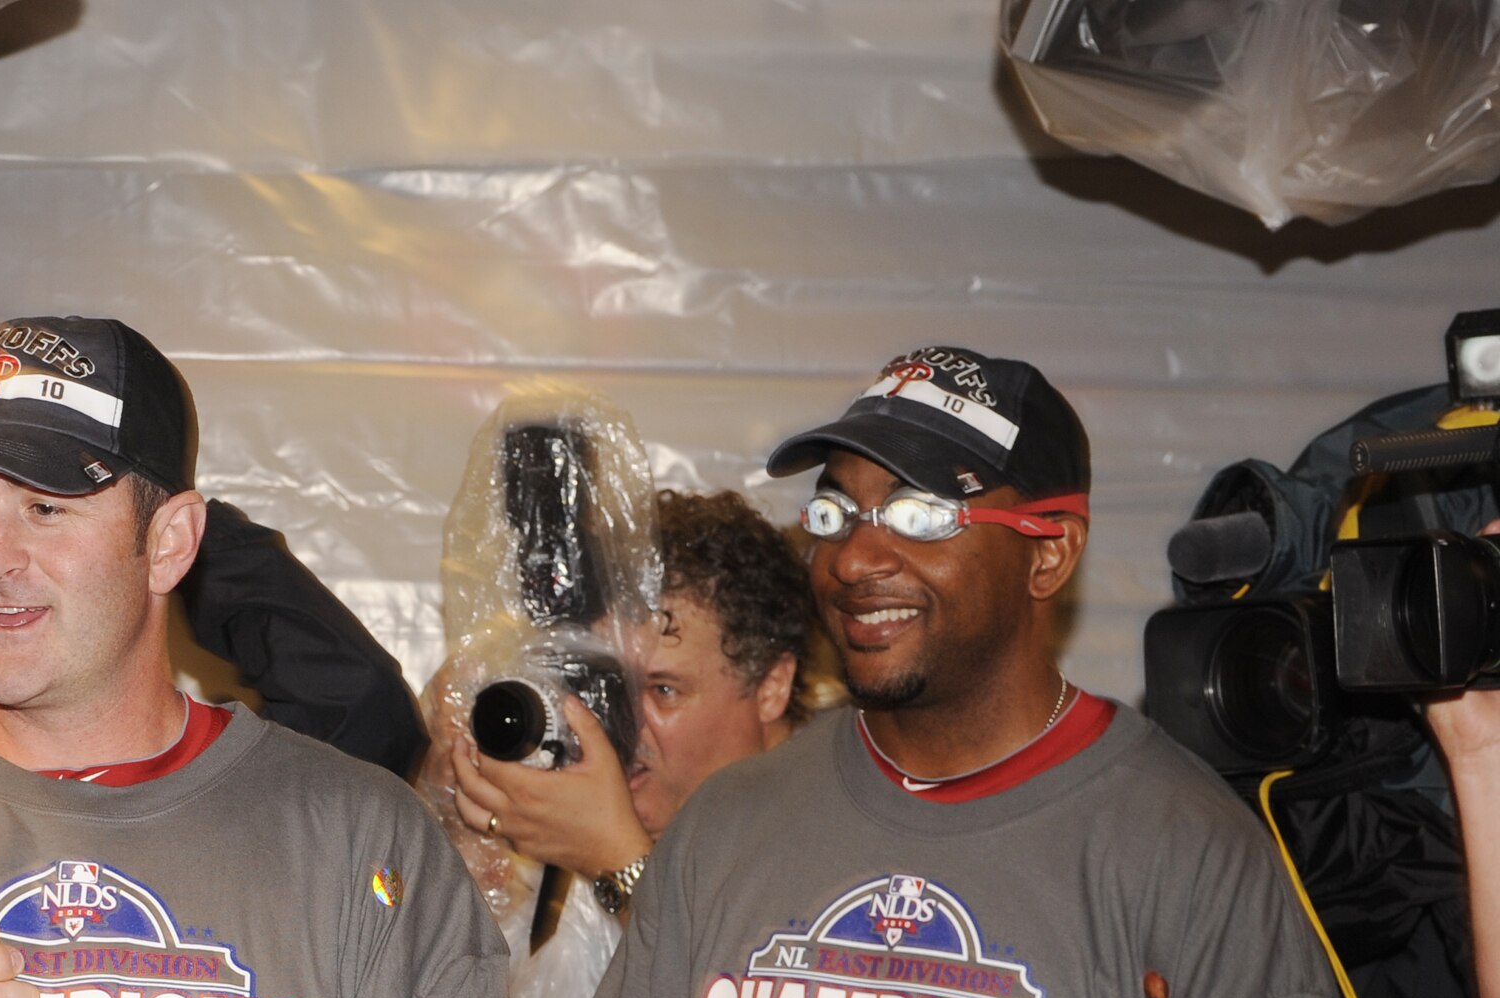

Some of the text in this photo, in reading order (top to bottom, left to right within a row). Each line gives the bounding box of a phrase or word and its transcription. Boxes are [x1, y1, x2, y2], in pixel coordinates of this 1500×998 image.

[39, 379, 65, 401] 10
[942, 396, 965, 414] 10
[40, 882, 117, 911] NLDS
[868, 892, 937, 923] NLDS
[20, 947, 221, 982] AST DIVISION
[774, 945, 1015, 996] NL EAST DIVISION
